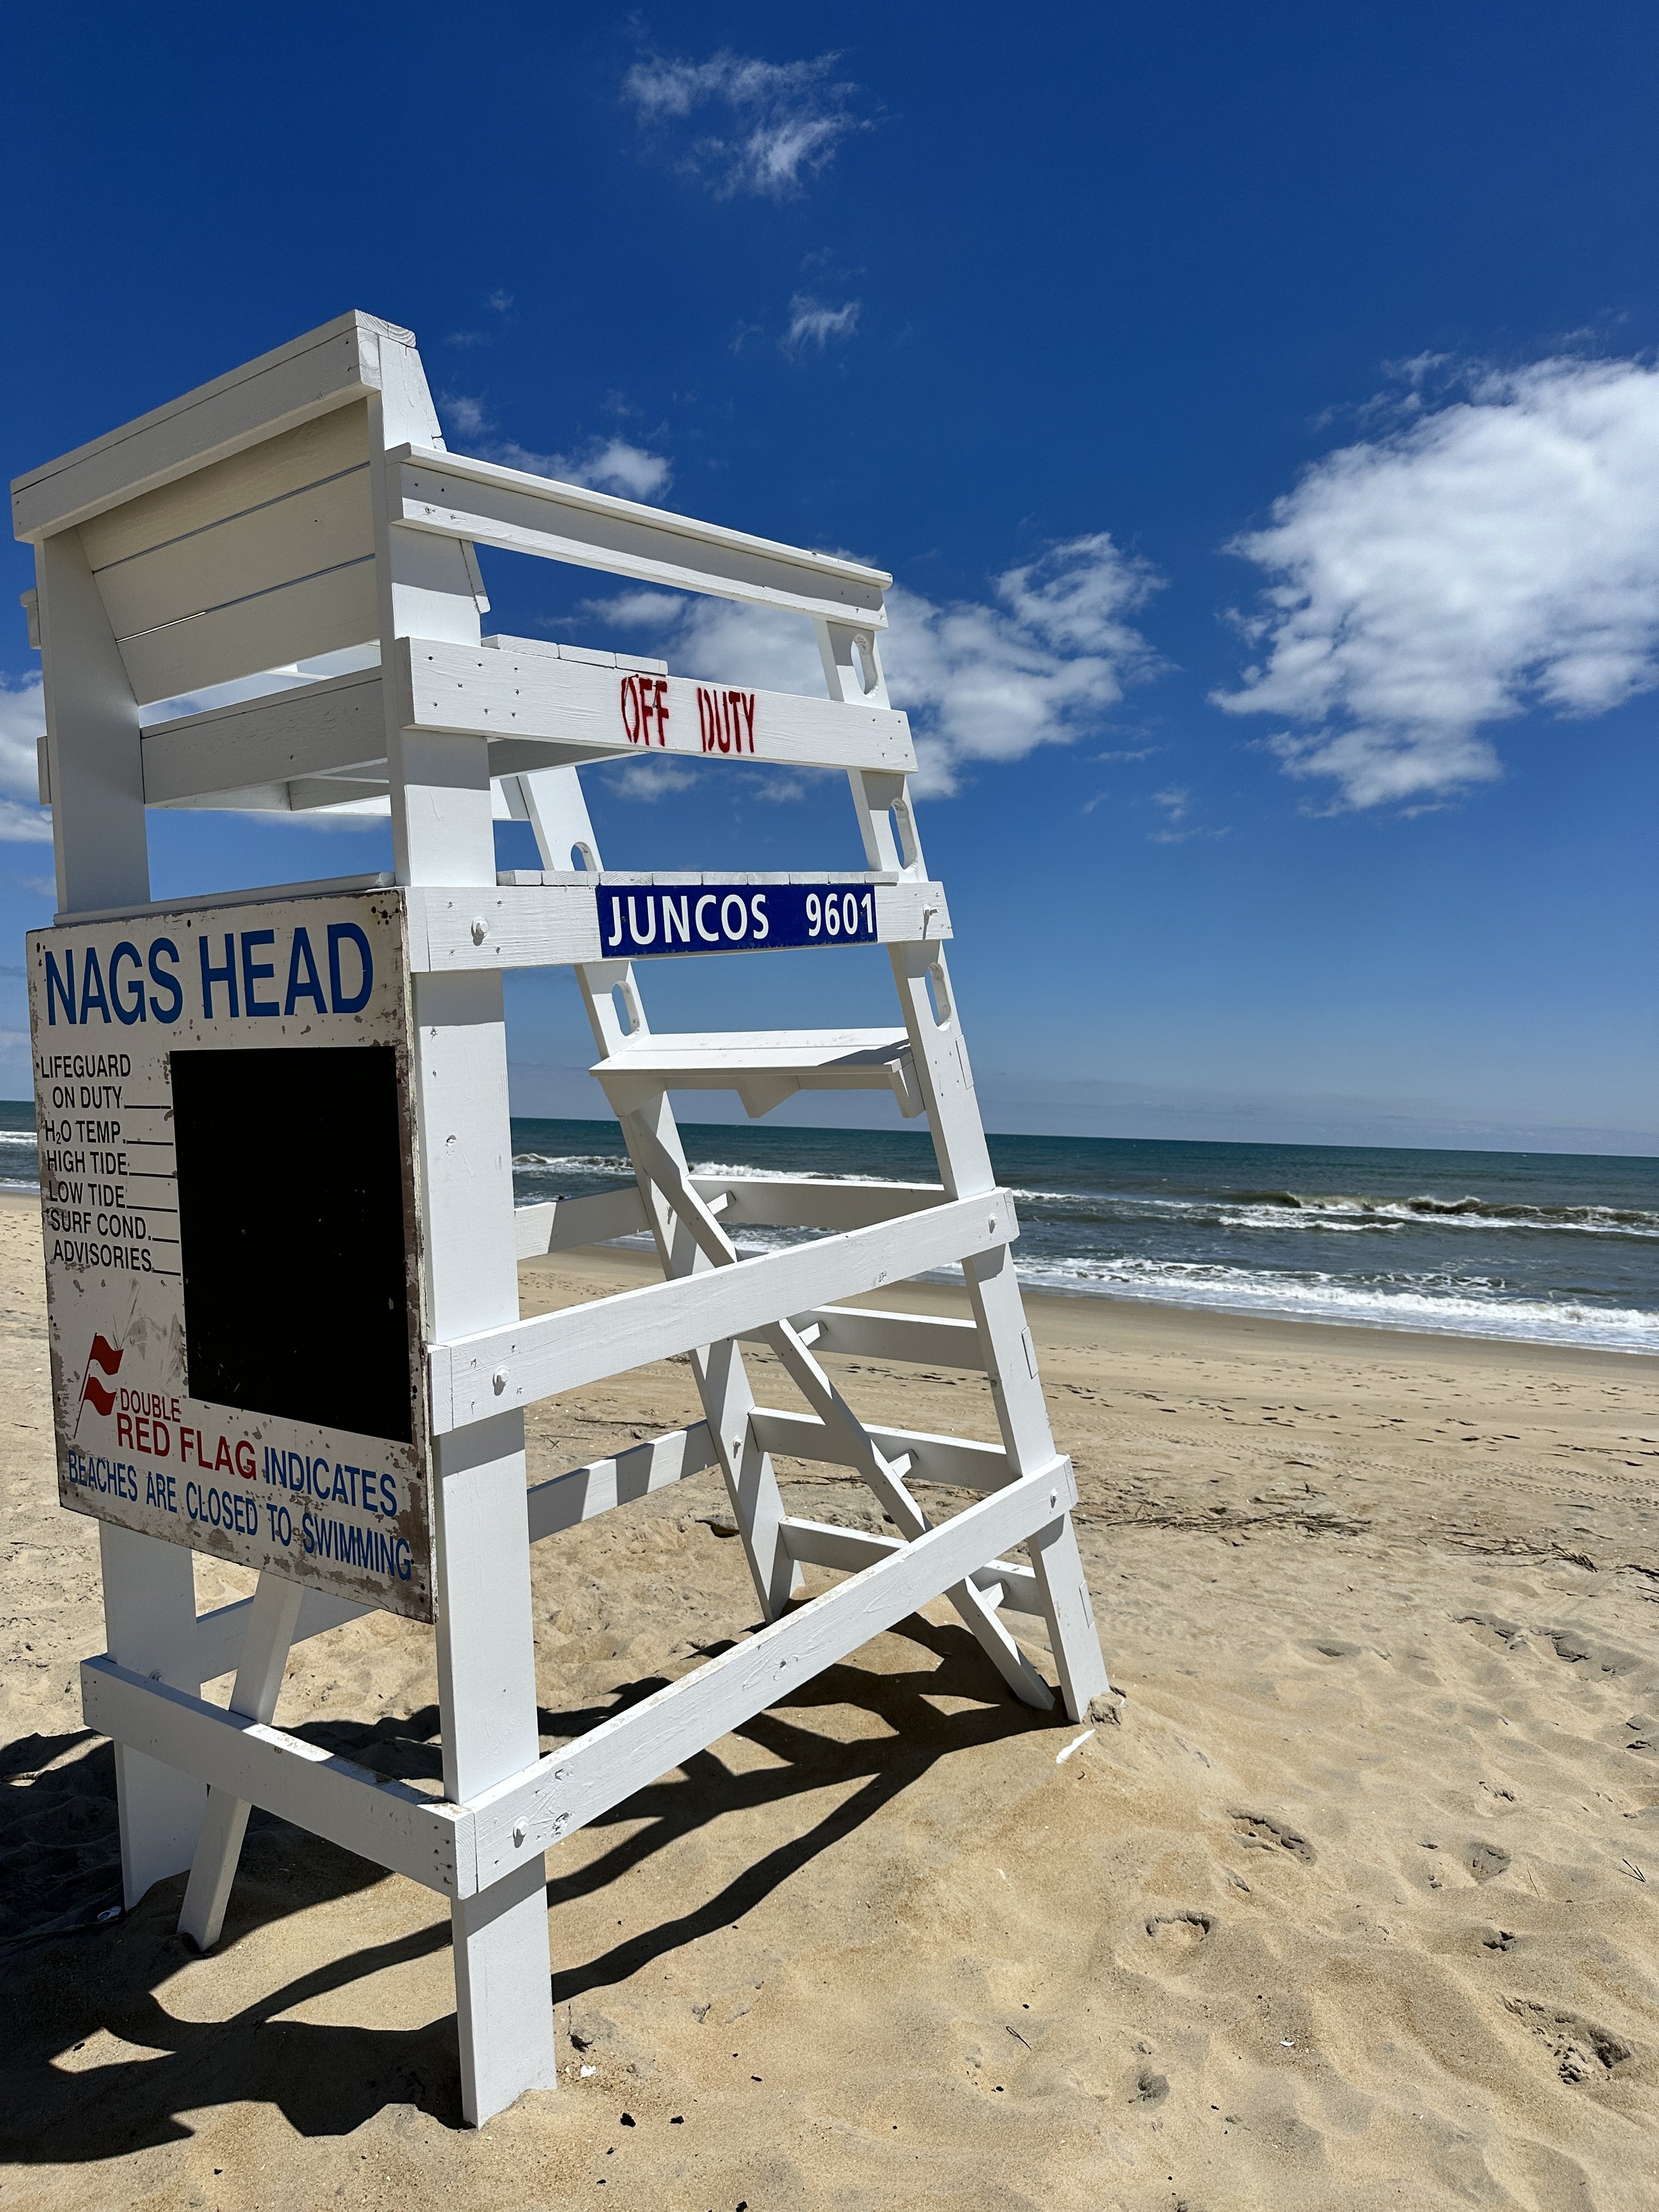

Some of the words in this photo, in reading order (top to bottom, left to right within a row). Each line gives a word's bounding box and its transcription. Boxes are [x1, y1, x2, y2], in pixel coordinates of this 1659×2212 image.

[620, 674, 670, 747] OFF
[696, 687, 755, 753] DUTY
[608, 894, 770, 946] JUNCOS
[806, 893, 874, 936] 9601
[45, 937, 183, 1026] NAGS
[199, 922, 374, 1019] HEAD
[40, 1053, 131, 1078] LIFEGUARD
[52, 1087, 76, 1109] ON
[80, 1086, 123, 1109] DUTY
[75, 1120, 127, 1145] TEMP.
[46, 1151, 86, 1174] HIGH
[90, 1151, 128, 1176] TIDE
[48, 1181, 83, 1205] LOW
[88, 1183, 126, 1209] TIDE
[50, 1211, 92, 1236] SURF
[97, 1213, 152, 1242] COND.
[53, 1240, 153, 1273] ADVISORIES
[119, 1388, 180, 1422] DOUBLE
[116, 1412, 171, 1457] RED
[180, 1428, 257, 1481] FLAG
[265, 1446, 397, 1517] INDICATES
[68, 1450, 137, 1502] BEACHES
[146, 1471, 178, 1514] ARE
[186, 1482, 258, 1536] CLOSED
[266, 1502, 292, 1547] TO
[303, 1513, 412, 1581] SWIMMING
